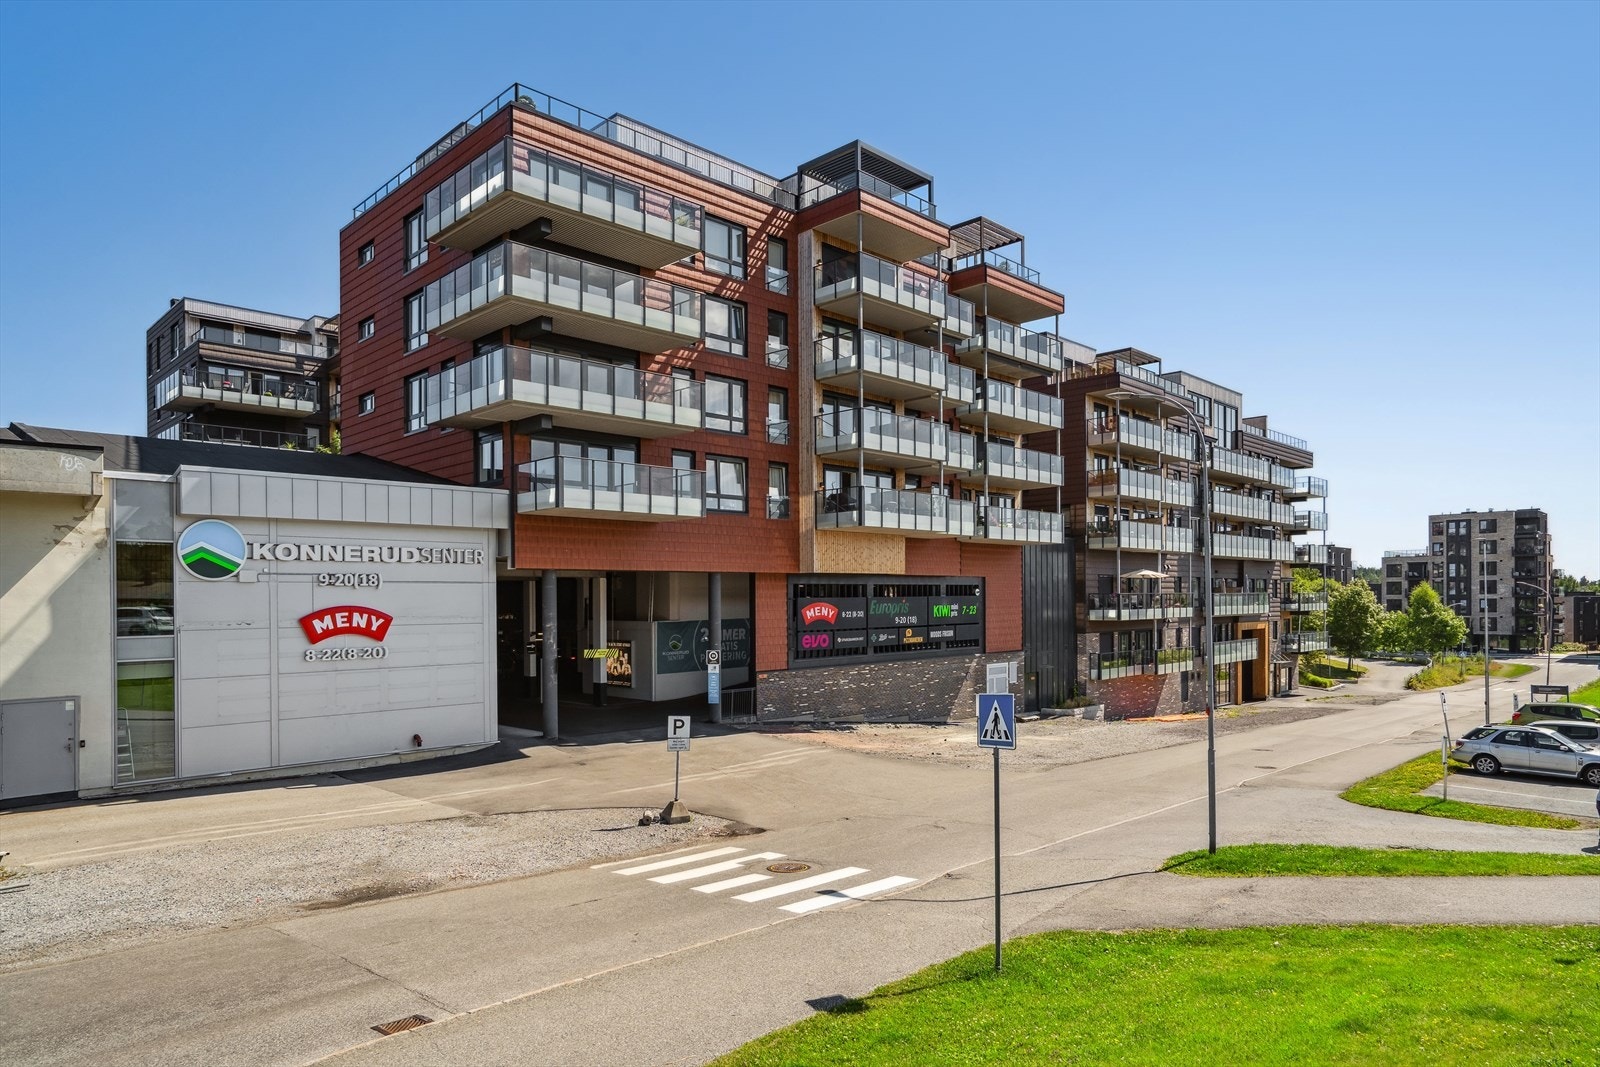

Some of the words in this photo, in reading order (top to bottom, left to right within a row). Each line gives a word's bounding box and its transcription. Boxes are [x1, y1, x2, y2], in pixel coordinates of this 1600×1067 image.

[318, 573, 383, 589] 9-20(18)
[806, 606, 835, 619] MENY
[870, 599, 909, 617] Europris
[933, 604, 951, 617] KIWI
[312, 612, 384, 634] MENY
[802, 634, 829, 648] evo
[673, 718, 685, 735] P
